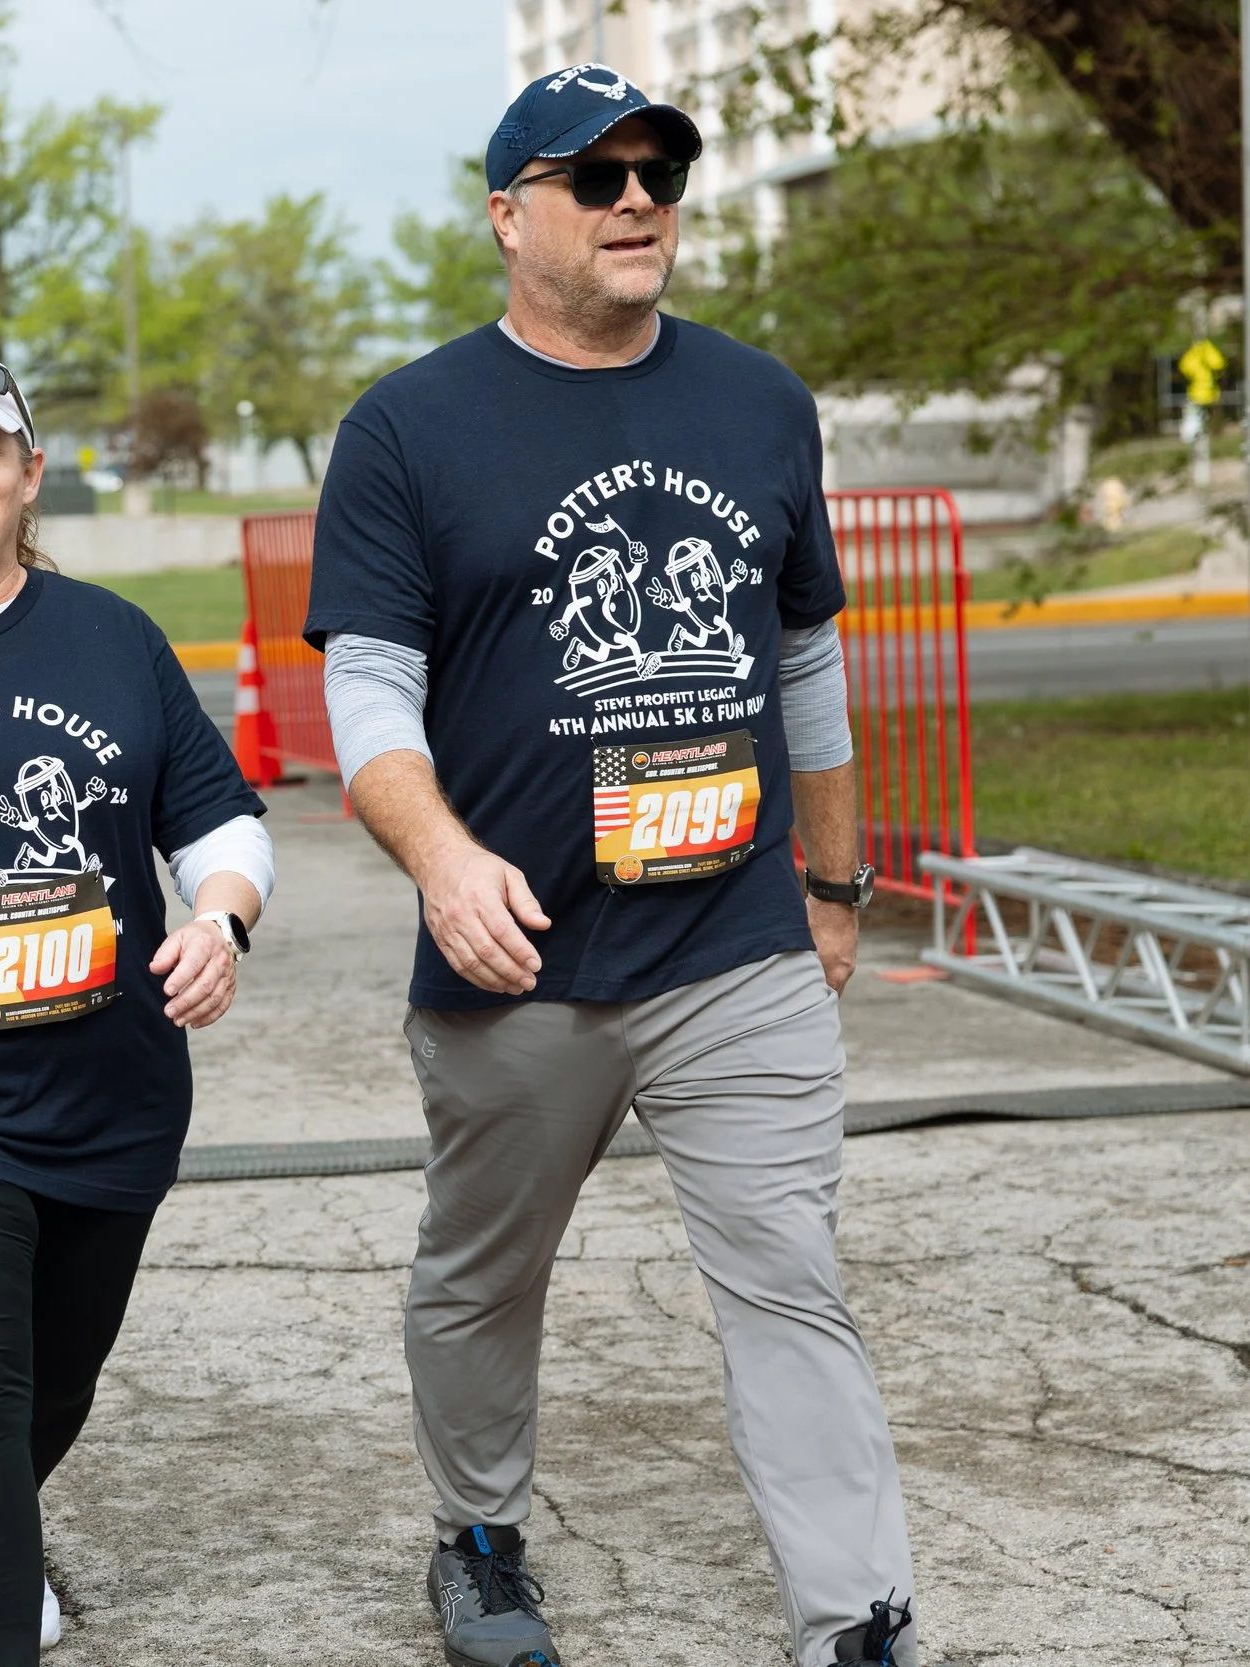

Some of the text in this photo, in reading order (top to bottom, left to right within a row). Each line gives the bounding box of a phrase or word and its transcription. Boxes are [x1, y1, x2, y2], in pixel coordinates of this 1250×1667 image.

[601, 121, 614, 133] AIR
[556, 150, 575, 158] FORCE
[534, 459, 761, 561] POTTER'S HOUSE
[750, 568, 763, 585] 26
[531, 588, 553, 605] 20
[594, 686, 736, 712] STEVE PROFFITT LEGACY
[549, 693, 766, 736] 4TH ANNUAL 5K & FUN RUN
[12, 696, 122, 766] HOUSE
[652, 742, 727, 762] HEARTLAND
[110, 788, 128, 804] 26
[630, 782, 743, 850] 2099
[1, 883, 77, 905] HEARTLAND
